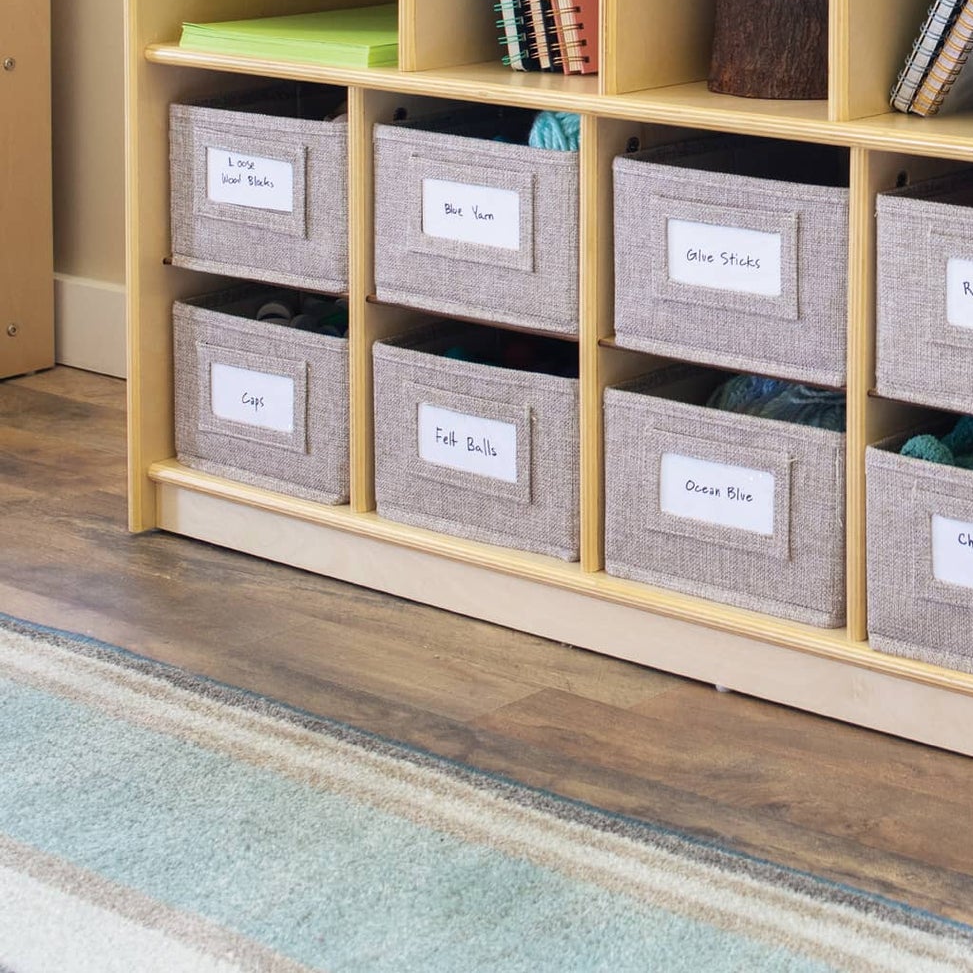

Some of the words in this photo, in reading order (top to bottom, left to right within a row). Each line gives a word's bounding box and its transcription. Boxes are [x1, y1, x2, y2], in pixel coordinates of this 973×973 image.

[228, 156, 256, 170] Loose
[444, 202, 464, 217] Blue
[471, 204, 495, 221] Yarn
[686, 248, 714, 263] Glue
[720, 251, 761, 269] Sticks
[241, 391, 265, 412] Caps
[435, 426, 459, 447] Felt
[466, 436, 498, 457] Balls
[684, 479, 722, 498] Ocean
[726, 486, 754, 503] Blue
